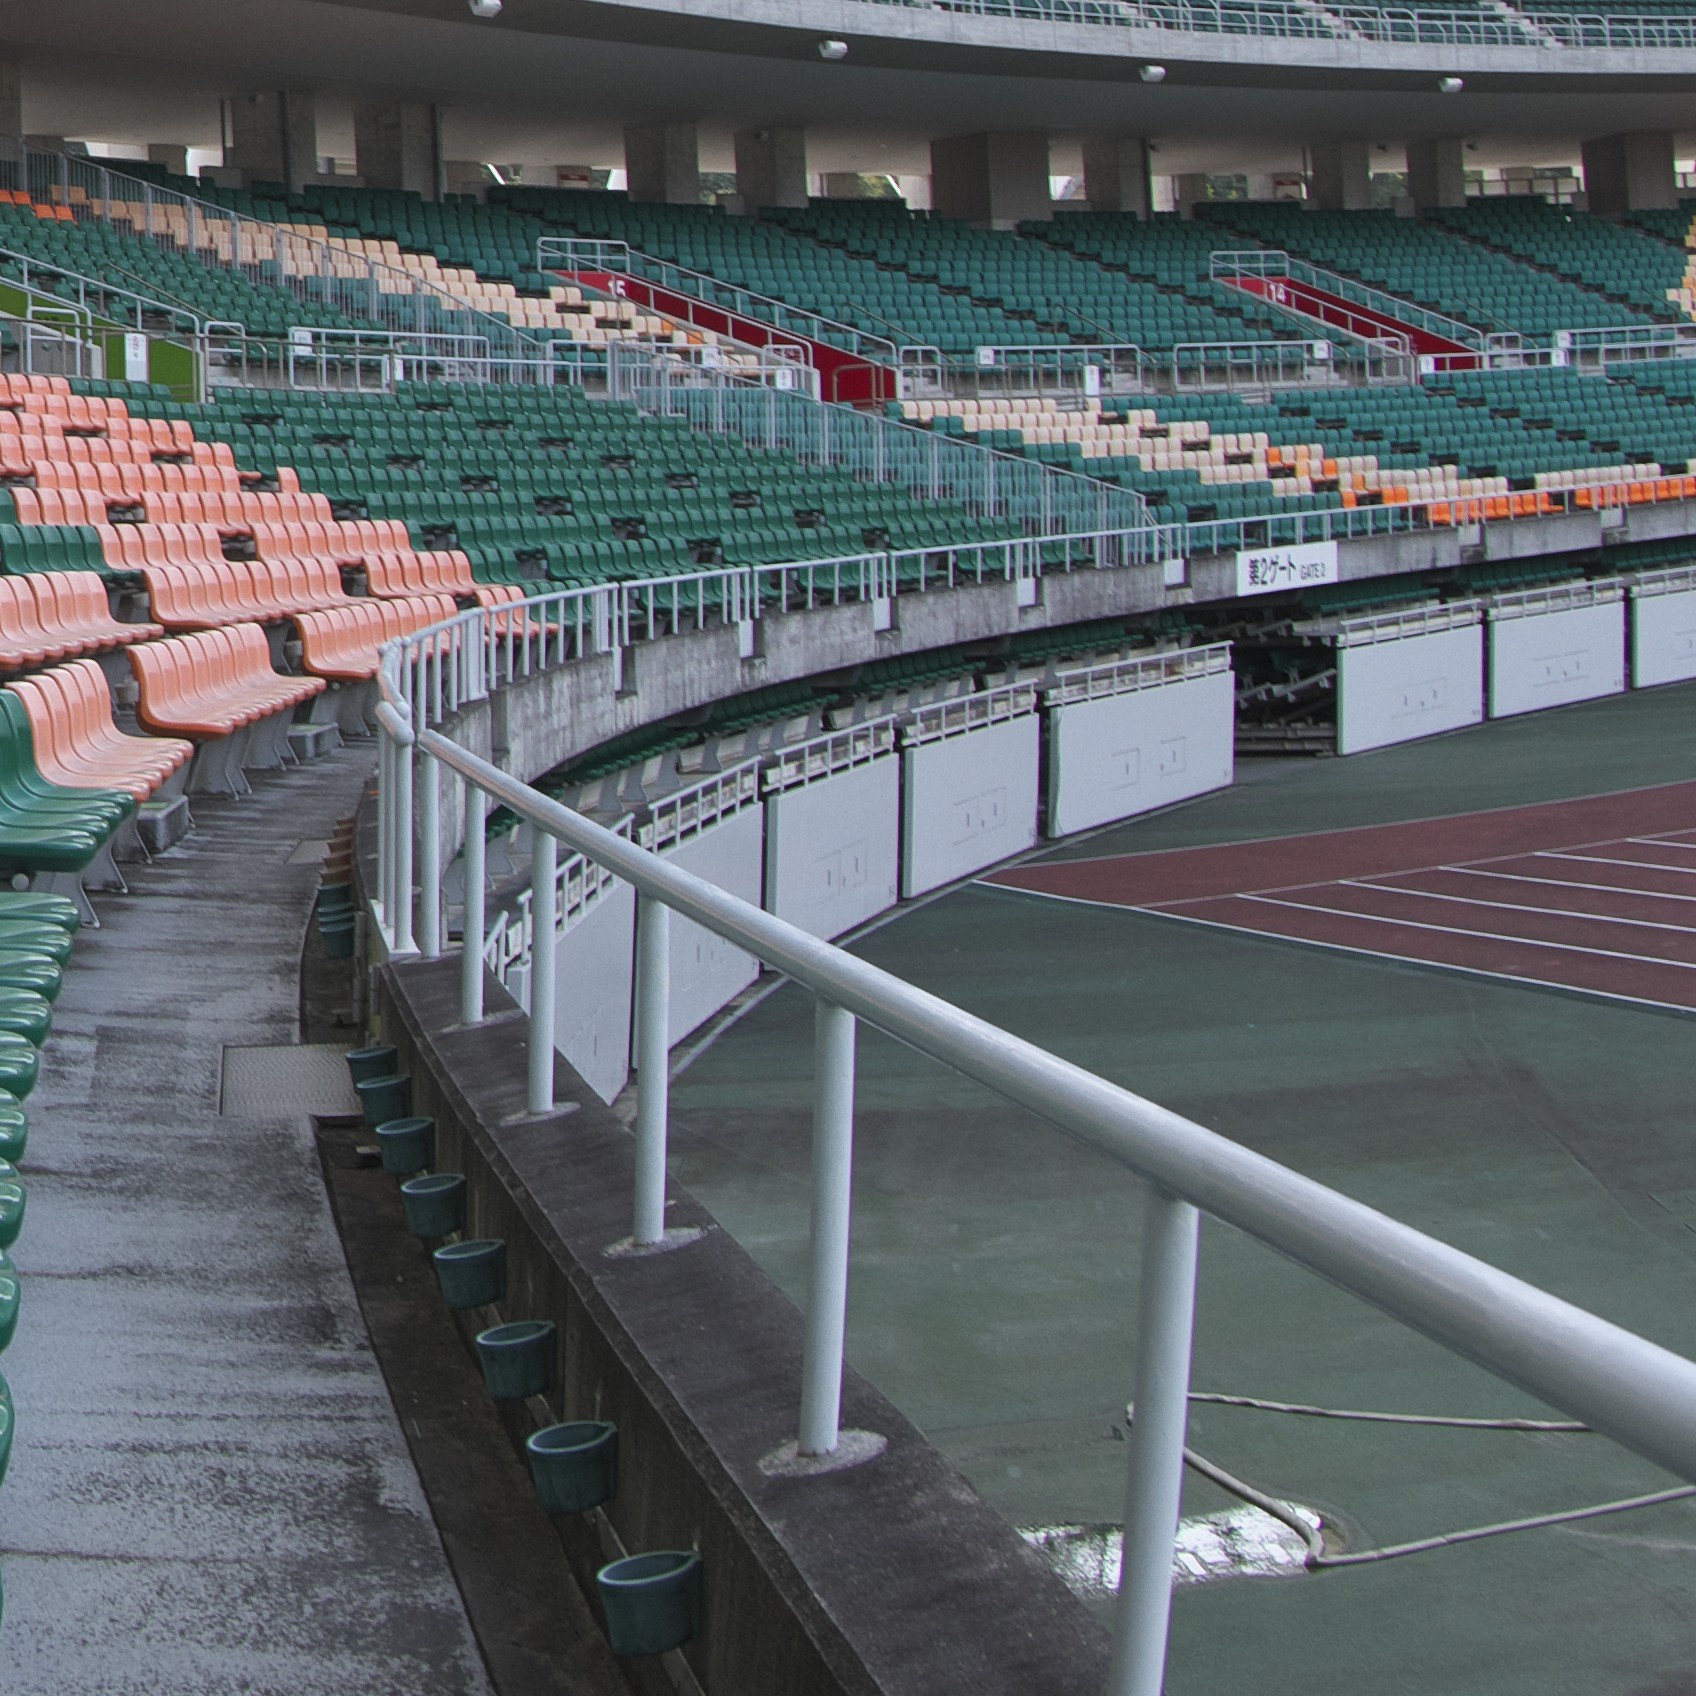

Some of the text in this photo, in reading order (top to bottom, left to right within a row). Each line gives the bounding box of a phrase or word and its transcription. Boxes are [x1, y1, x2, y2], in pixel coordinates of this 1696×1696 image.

[1269, 283, 1286, 301] 14
[1249, 553, 1296, 587] 第2ゲート
[1301, 562, 1319, 581] GATE
